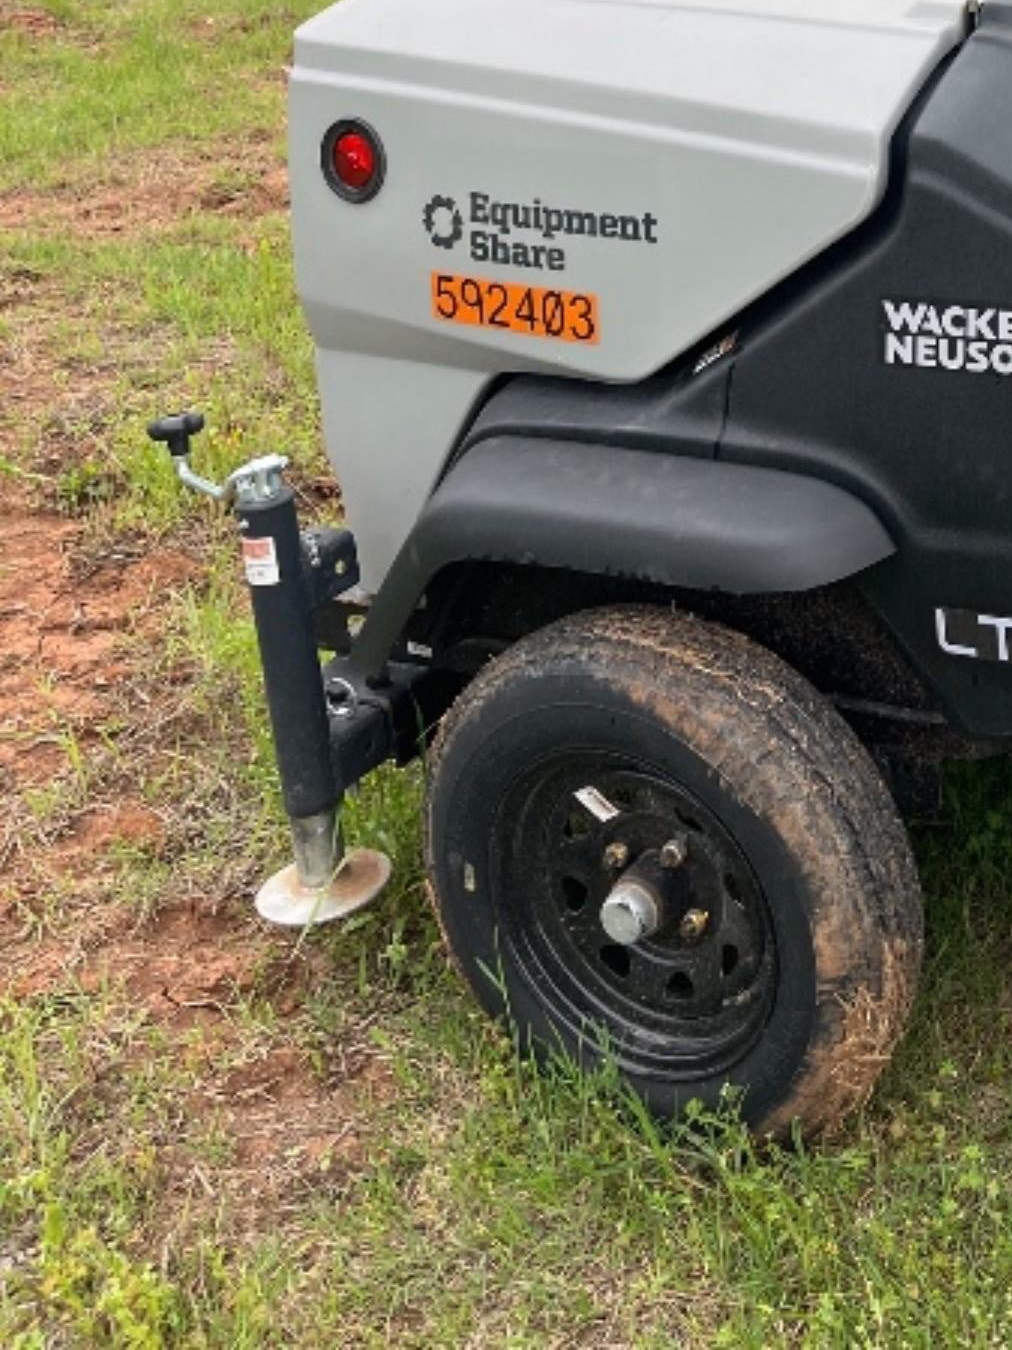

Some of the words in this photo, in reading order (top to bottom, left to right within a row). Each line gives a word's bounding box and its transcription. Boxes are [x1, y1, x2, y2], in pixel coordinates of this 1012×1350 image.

[469, 191, 658, 243] Equipment
[470, 230, 565, 271] Share
[436, 275, 595, 340] 592403
